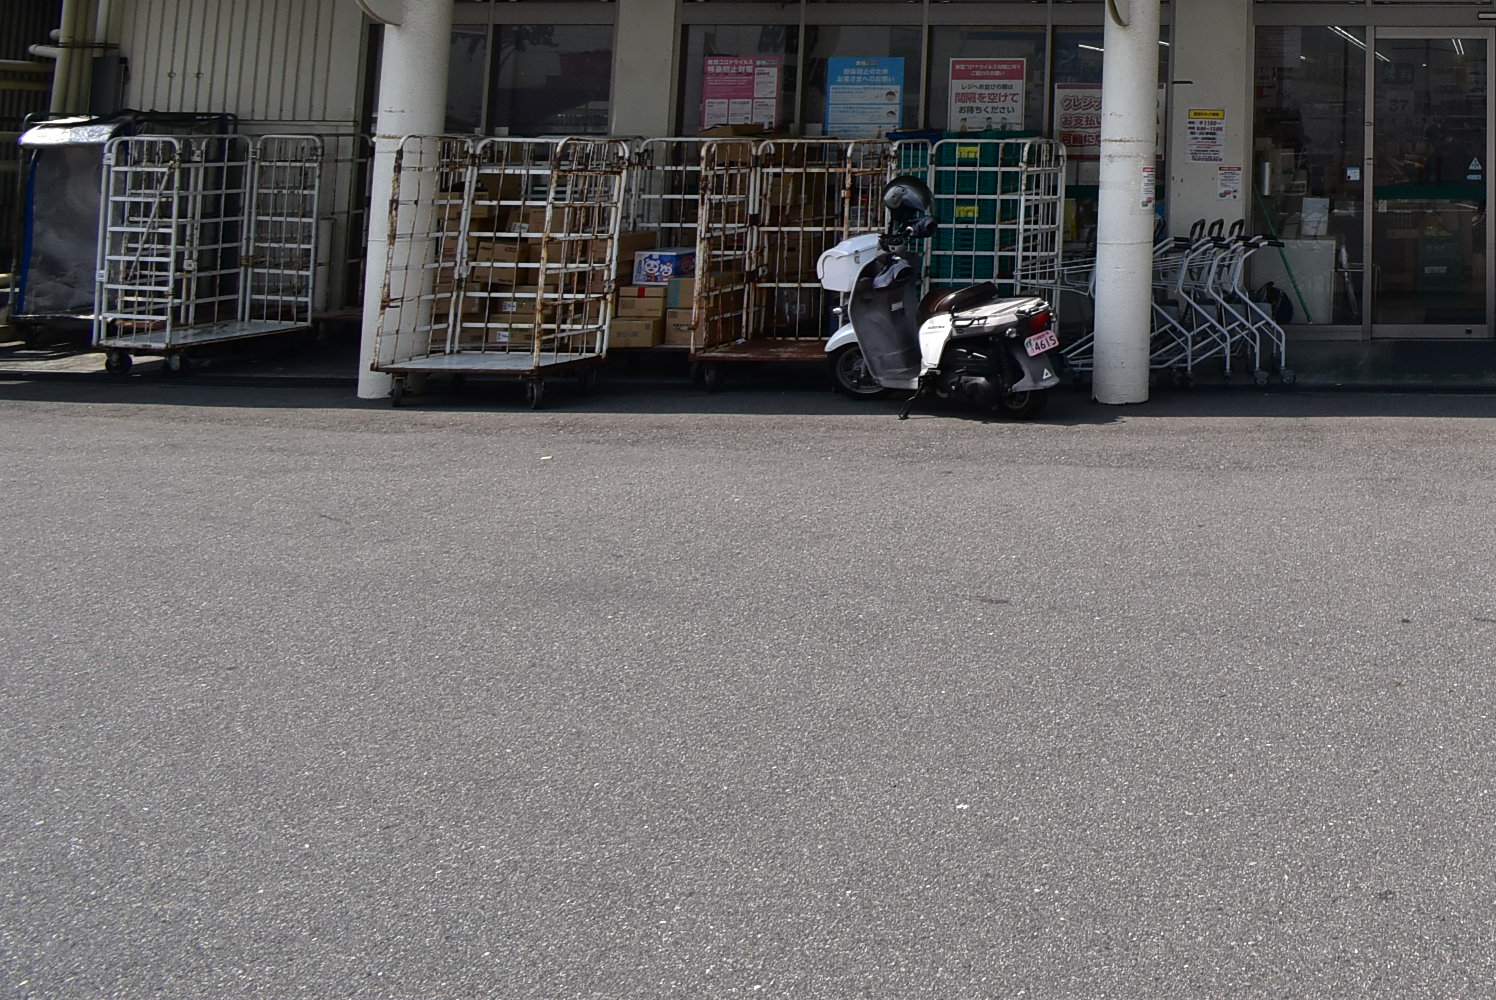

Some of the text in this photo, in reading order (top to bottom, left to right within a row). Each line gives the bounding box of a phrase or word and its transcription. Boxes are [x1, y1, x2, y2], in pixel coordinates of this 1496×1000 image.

[955, 92, 1019, 104] 間隔を空けて
[958, 105, 1015, 114] お待ちください
[1035, 335, 1057, 351] 4615
